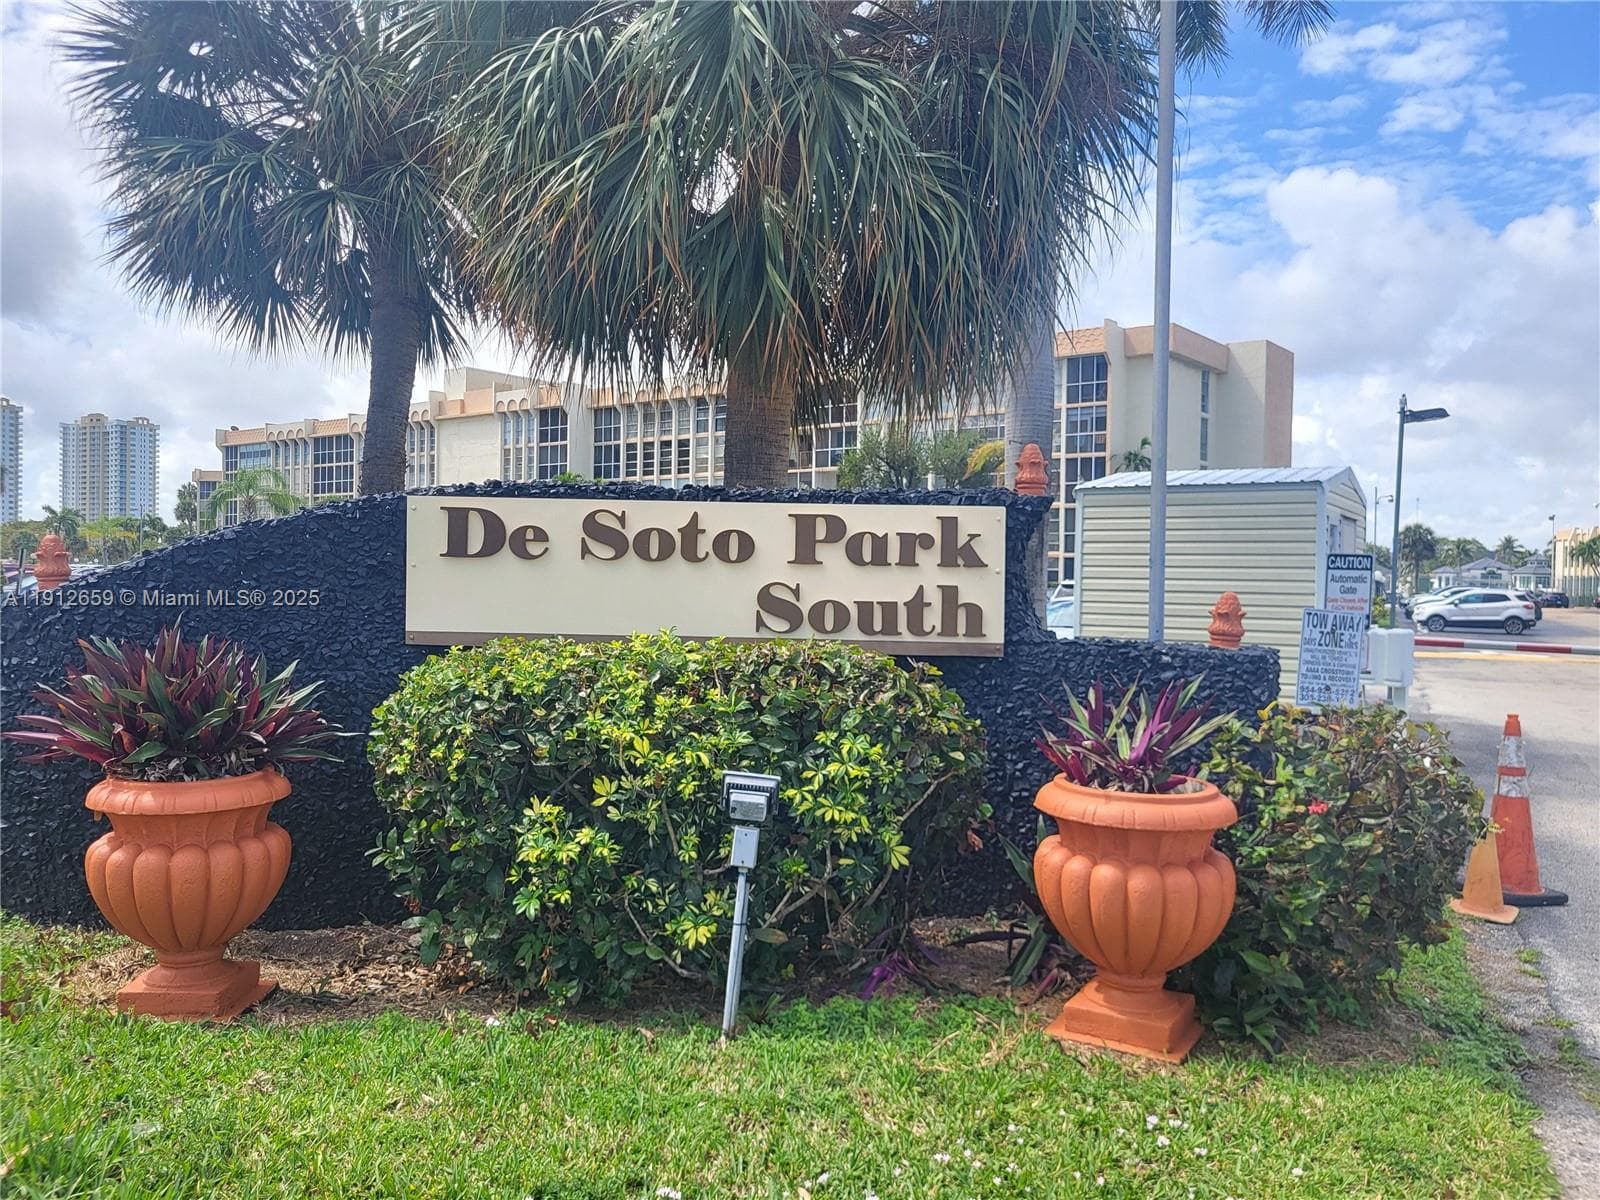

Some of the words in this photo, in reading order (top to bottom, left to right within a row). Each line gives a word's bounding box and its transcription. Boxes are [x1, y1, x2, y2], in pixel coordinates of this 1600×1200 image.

[439, 505, 550, 560] De
[580, 508, 756, 564] Soto
[786, 512, 988, 569] Park
[1328, 556, 1371, 569] CAUTION
[1330, 573, 1367, 584] Automatic
[1339, 585, 1357, 595] Gate
[754, 581, 987, 638] South
[1306, 611, 1328, 629] TOW
[1331, 614, 1361, 632] AWAY
[1317, 630, 1344, 648] ZONE
